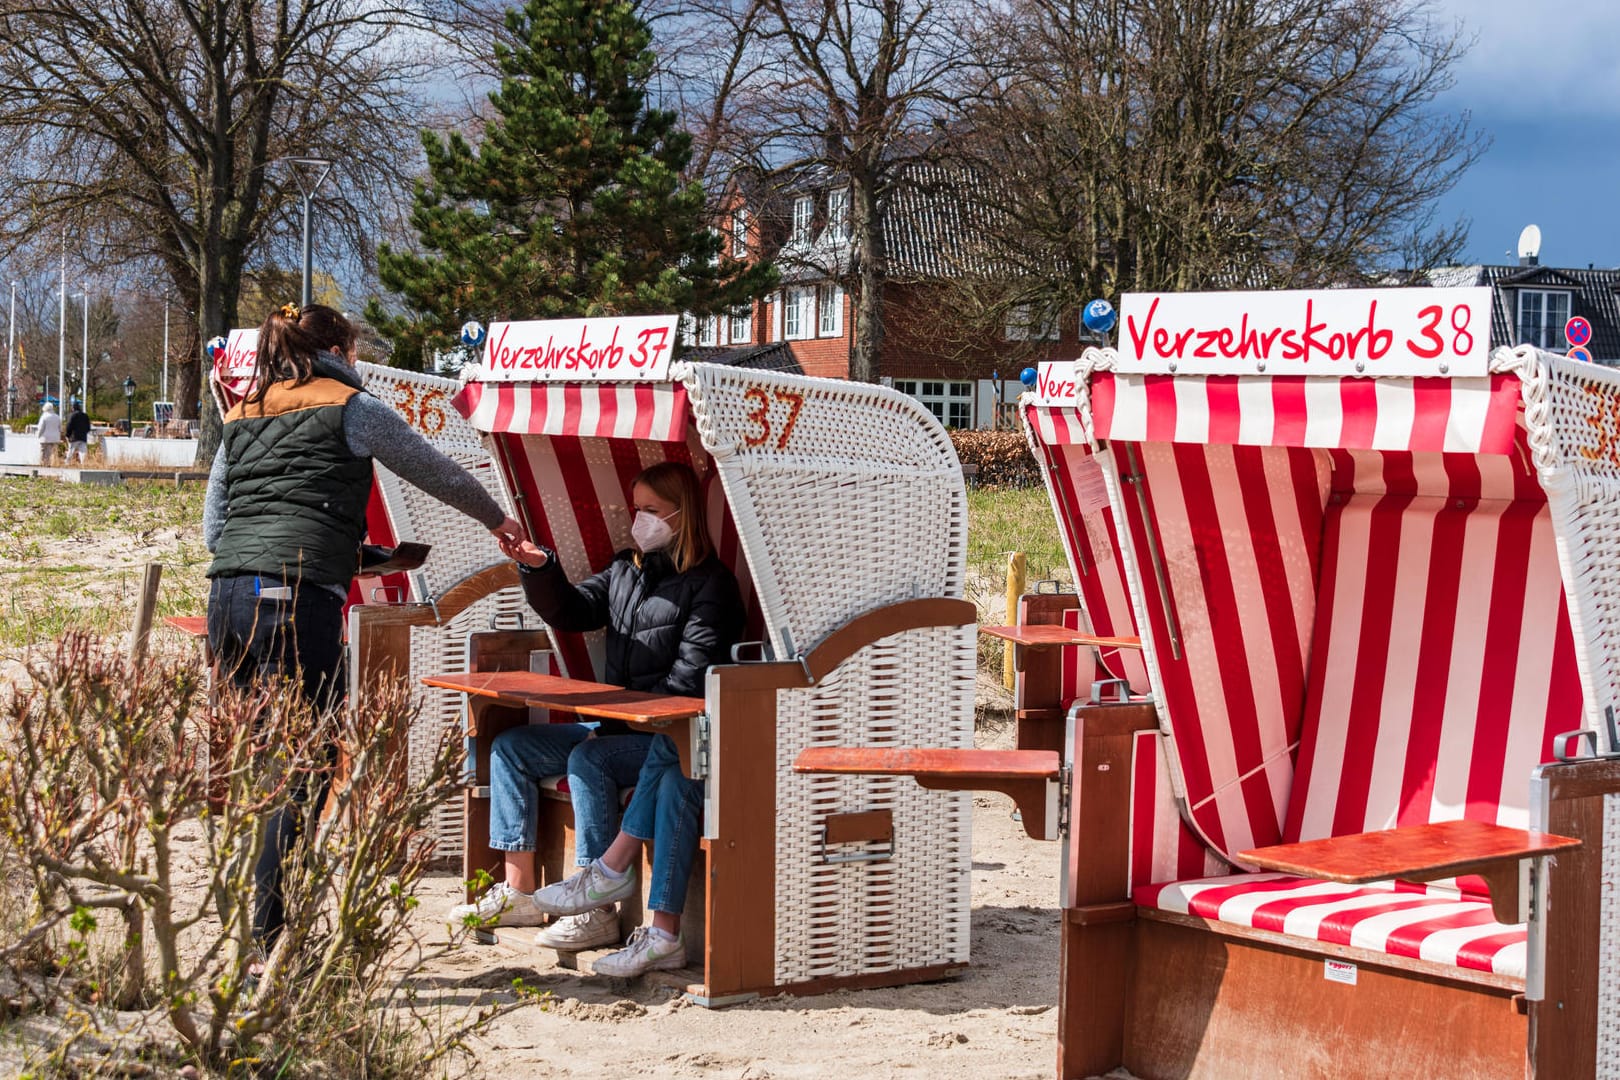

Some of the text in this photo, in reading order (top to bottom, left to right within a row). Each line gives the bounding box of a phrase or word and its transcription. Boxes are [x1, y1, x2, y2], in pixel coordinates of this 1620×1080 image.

[488, 324, 669, 371] Verzehrskorb 37
[1127, 297, 1475, 363] Verzehrskorb 38
[394, 382, 446, 436] 36
[742, 386, 804, 450] 37
